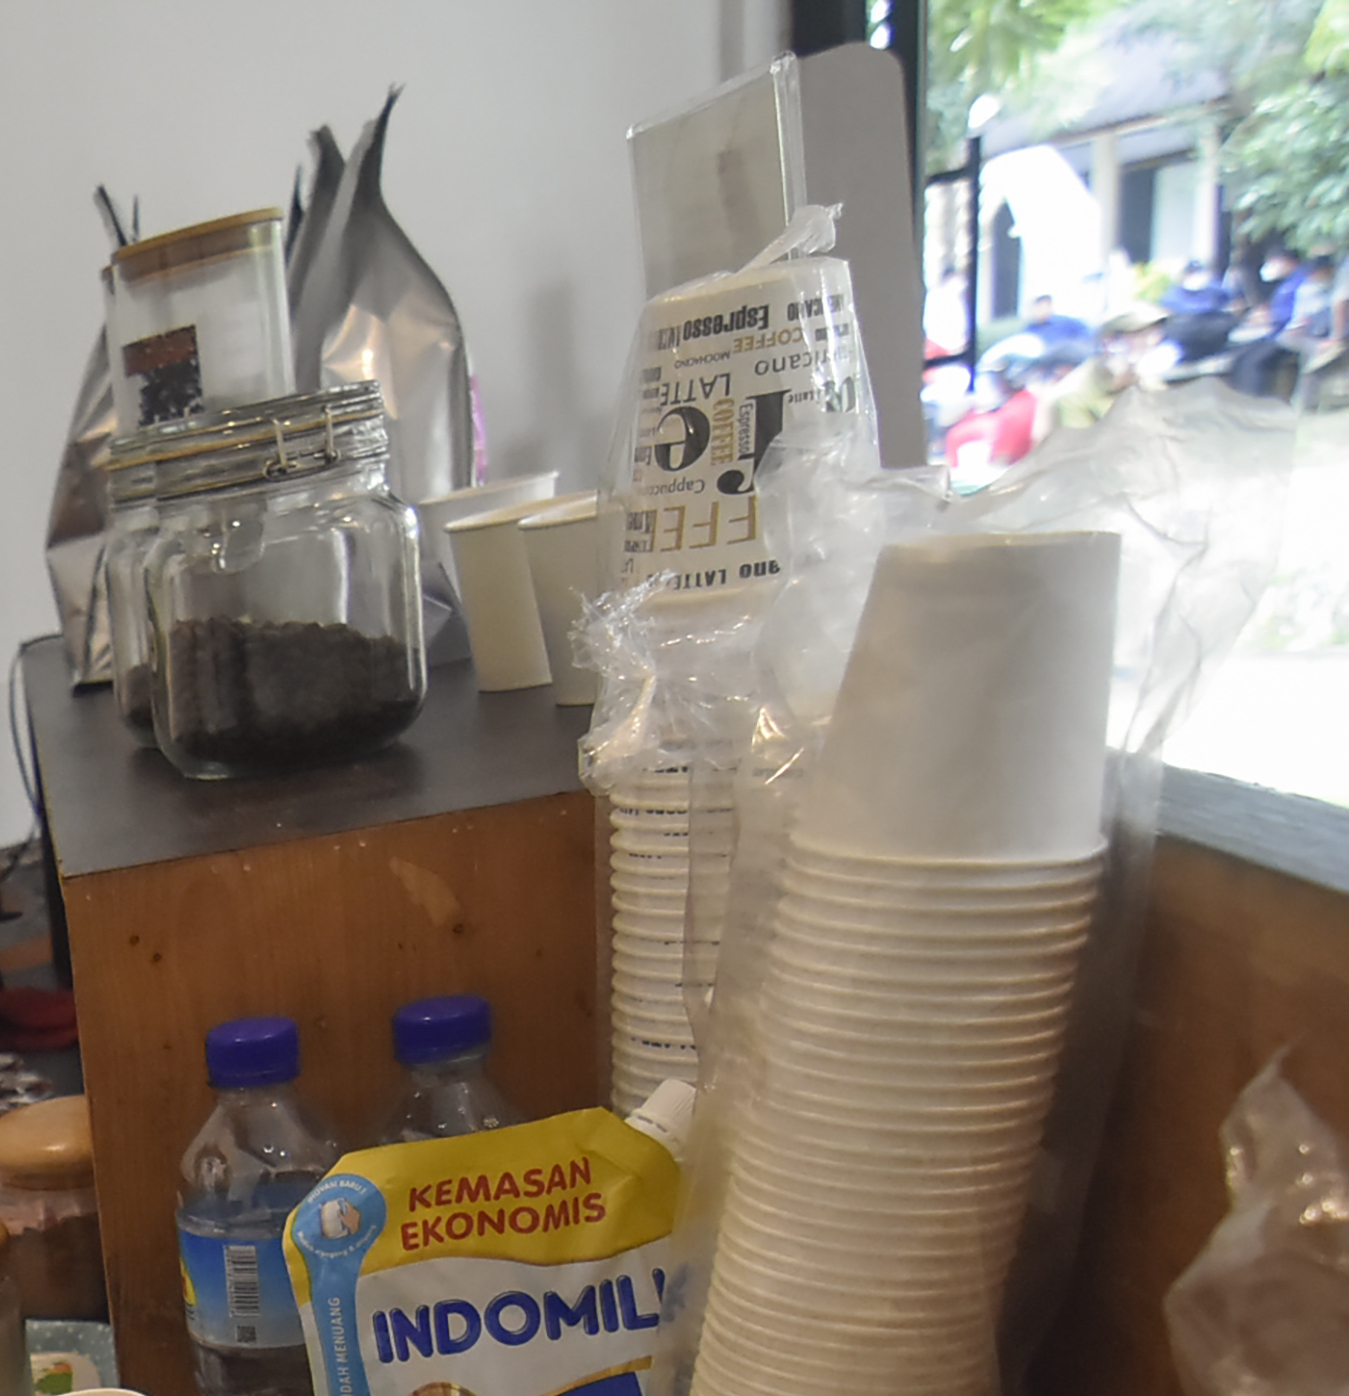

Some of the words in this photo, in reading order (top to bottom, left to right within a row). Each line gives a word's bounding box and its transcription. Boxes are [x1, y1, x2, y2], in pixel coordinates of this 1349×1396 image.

[683, 304, 770, 341] Espresso
[733, 326, 804, 353] COFFEE
[660, 372, 731, 406] LATTE
[711, 398, 736, 466] COFFEE
[737, 403, 754, 455] Espresso
[408, 1156, 592, 1213] KEMASAN
[401, 1193, 607, 1251] EKONOMIS
[328, 1297, 347, 1362] MENUANG
